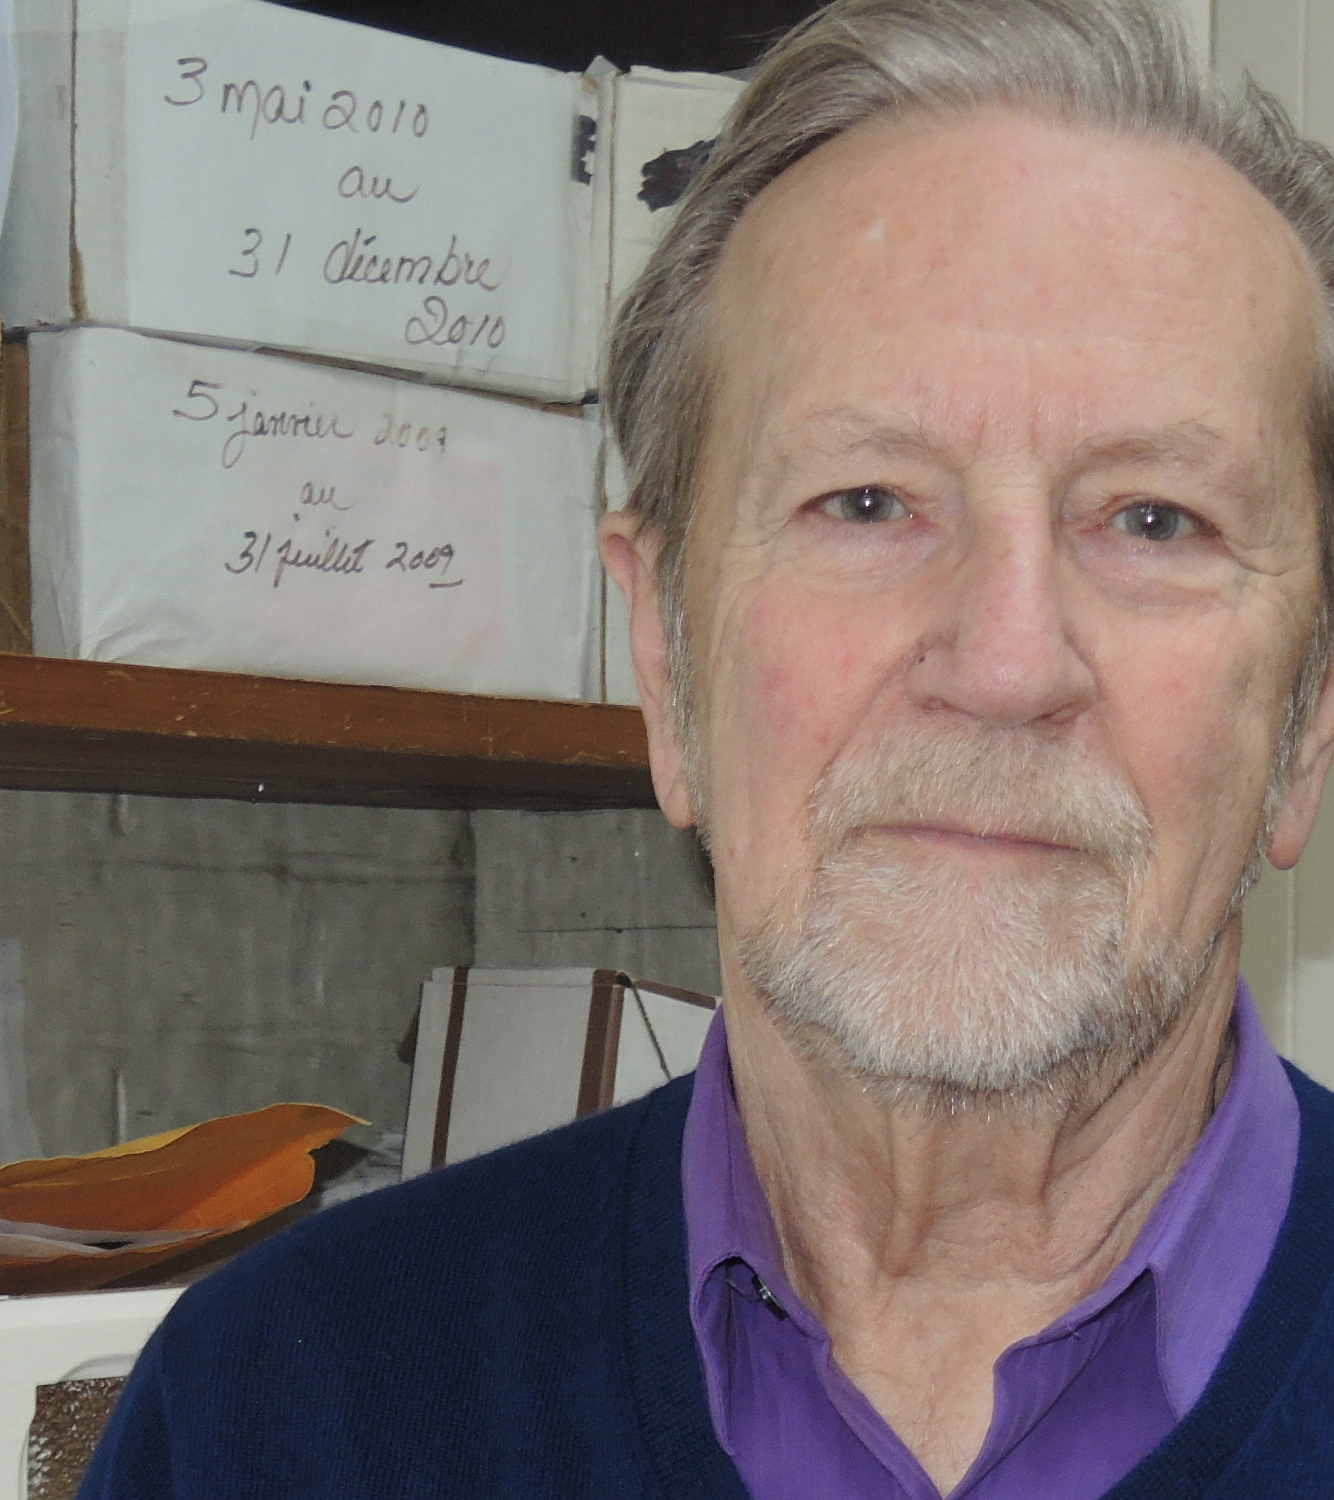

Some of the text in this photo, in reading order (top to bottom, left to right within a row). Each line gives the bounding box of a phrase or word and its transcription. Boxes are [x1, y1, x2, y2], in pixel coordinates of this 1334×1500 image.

[164, 57, 429, 142] 3 mai 2010
[337, 165, 419, 203] au
[229, 228, 499, 291] 31 décembre
[403, 295, 506, 349] 2010
[173, 379, 225, 421] 5
[300, 481, 353, 511] au
[225, 512, 455, 589] 31 juillet 2009
